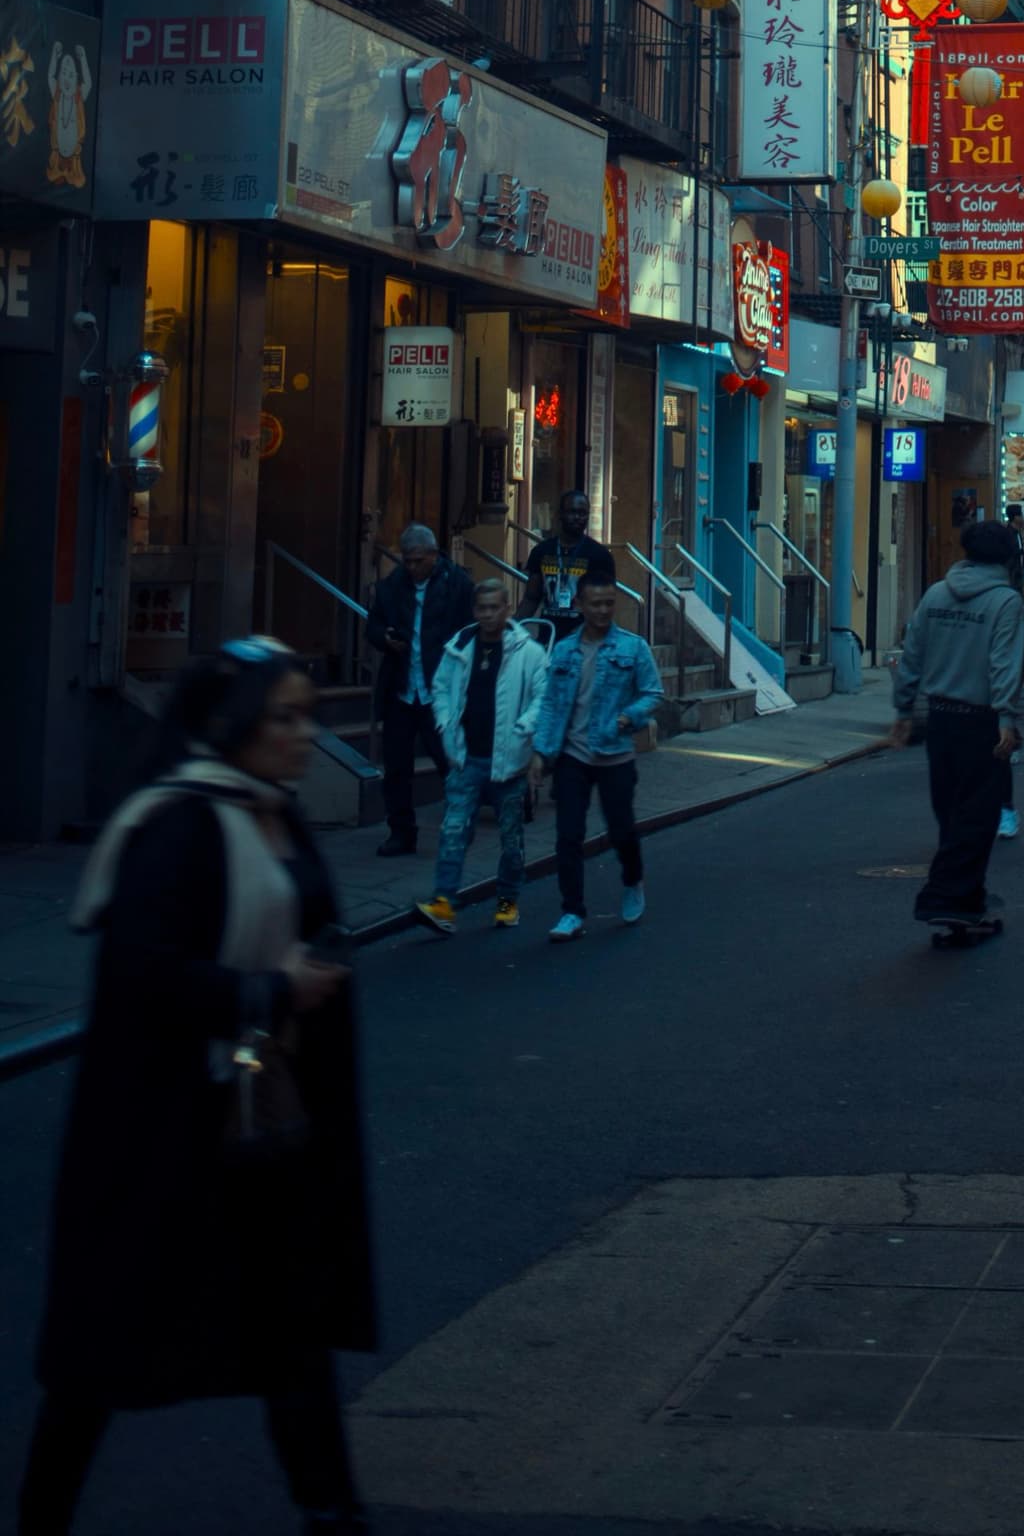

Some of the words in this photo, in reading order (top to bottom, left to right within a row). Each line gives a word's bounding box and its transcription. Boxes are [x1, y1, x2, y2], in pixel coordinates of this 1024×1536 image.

[125, 23, 258, 60] PELL
[120, 69, 176, 86] HAIR
[185, 68, 264, 85] SALON
[944, 72, 1024, 100] ir
[960, 105, 1005, 132] Le
[948, 135, 1014, 164] Pell
[960, 196, 998, 212] Color
[962, 219, 981, 233] Hair
[869, 238, 919, 258] Doyers
[971, 236, 1024, 250] Treatment
[940, 309, 1024, 322] 18Pell.com
[391, 347, 446, 364] PELL
[892, 353, 911, 406] 18
[895, 434, 914, 451] 18
